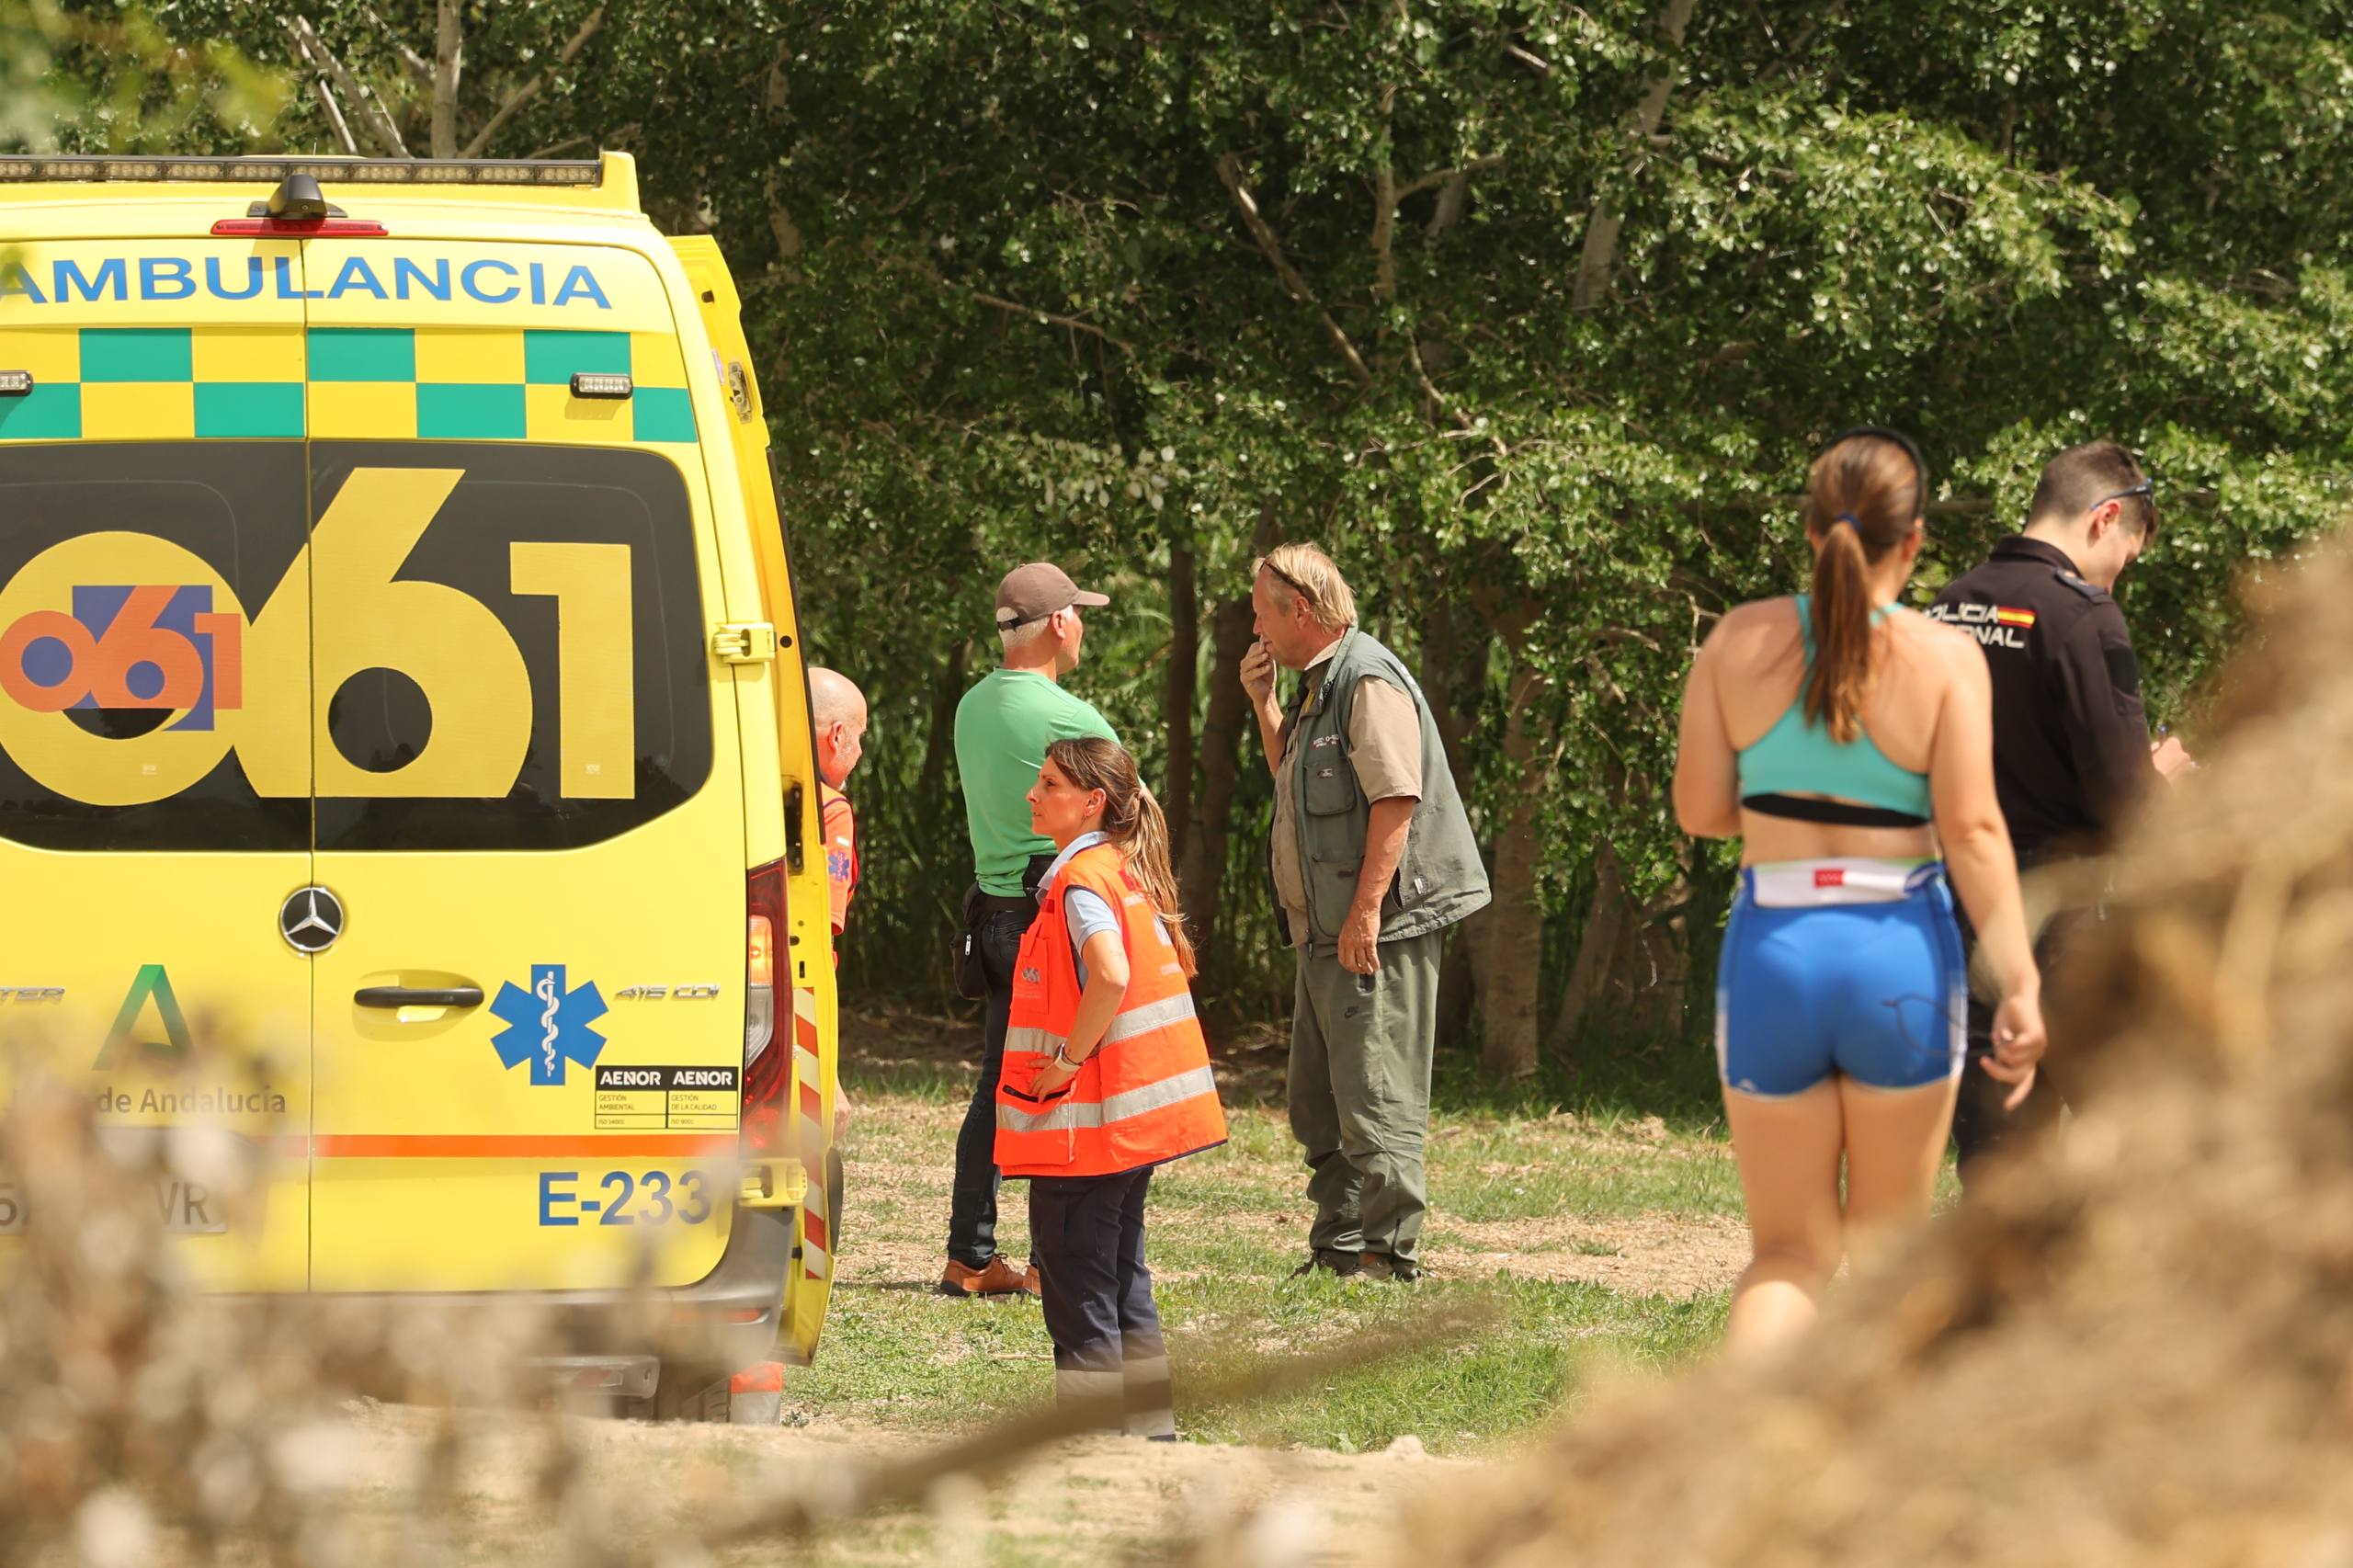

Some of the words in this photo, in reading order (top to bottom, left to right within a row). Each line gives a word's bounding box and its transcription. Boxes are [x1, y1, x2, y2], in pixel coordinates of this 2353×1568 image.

[0, 256, 613, 310] AMBULANCIA
[1925, 602, 1998, 624] OLICIA
[0, 467, 635, 806] 061
[0, 585, 243, 713] 061
[616, 984, 667, 999] 415
[673, 984, 721, 999] CDI
[599, 1071, 661, 1085] AENOR
[672, 1071, 733, 1085] AENOR
[97, 1086, 131, 1113] de
[139, 1085, 286, 1113] Andalucía
[598, 1094, 627, 1102] GESTIÓN
[671, 1094, 699, 1102] GESTIÓN
[539, 1170, 711, 1226] E-233
